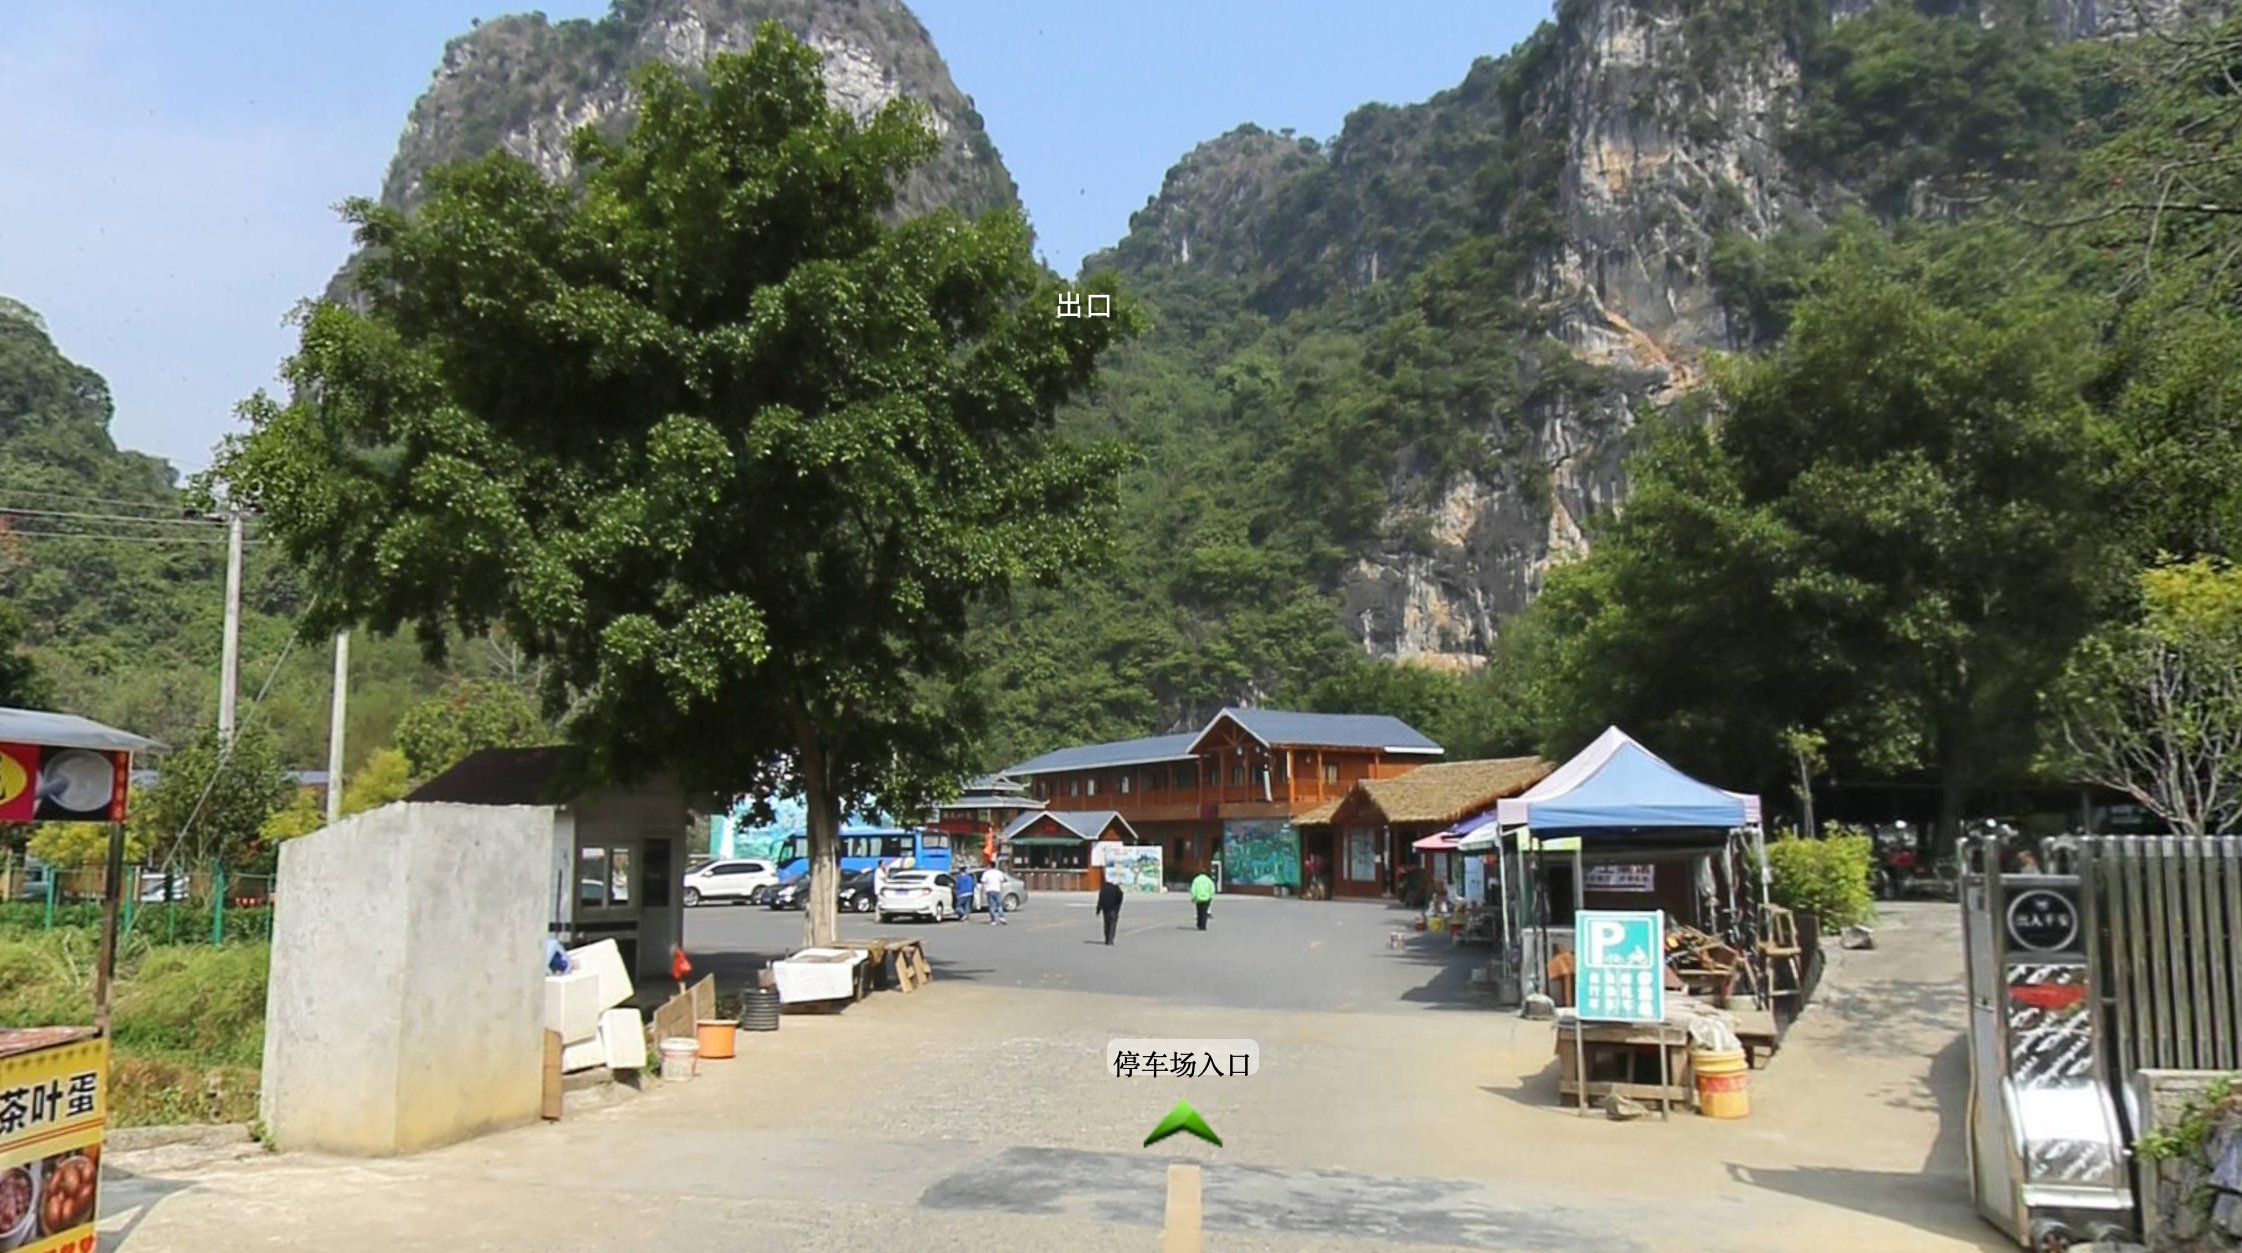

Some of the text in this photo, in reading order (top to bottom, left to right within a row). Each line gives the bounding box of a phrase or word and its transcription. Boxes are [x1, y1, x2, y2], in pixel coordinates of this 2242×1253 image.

[1589, 920, 1627, 966] P
[0, 1072, 97, 1135] 茶叶蛋
